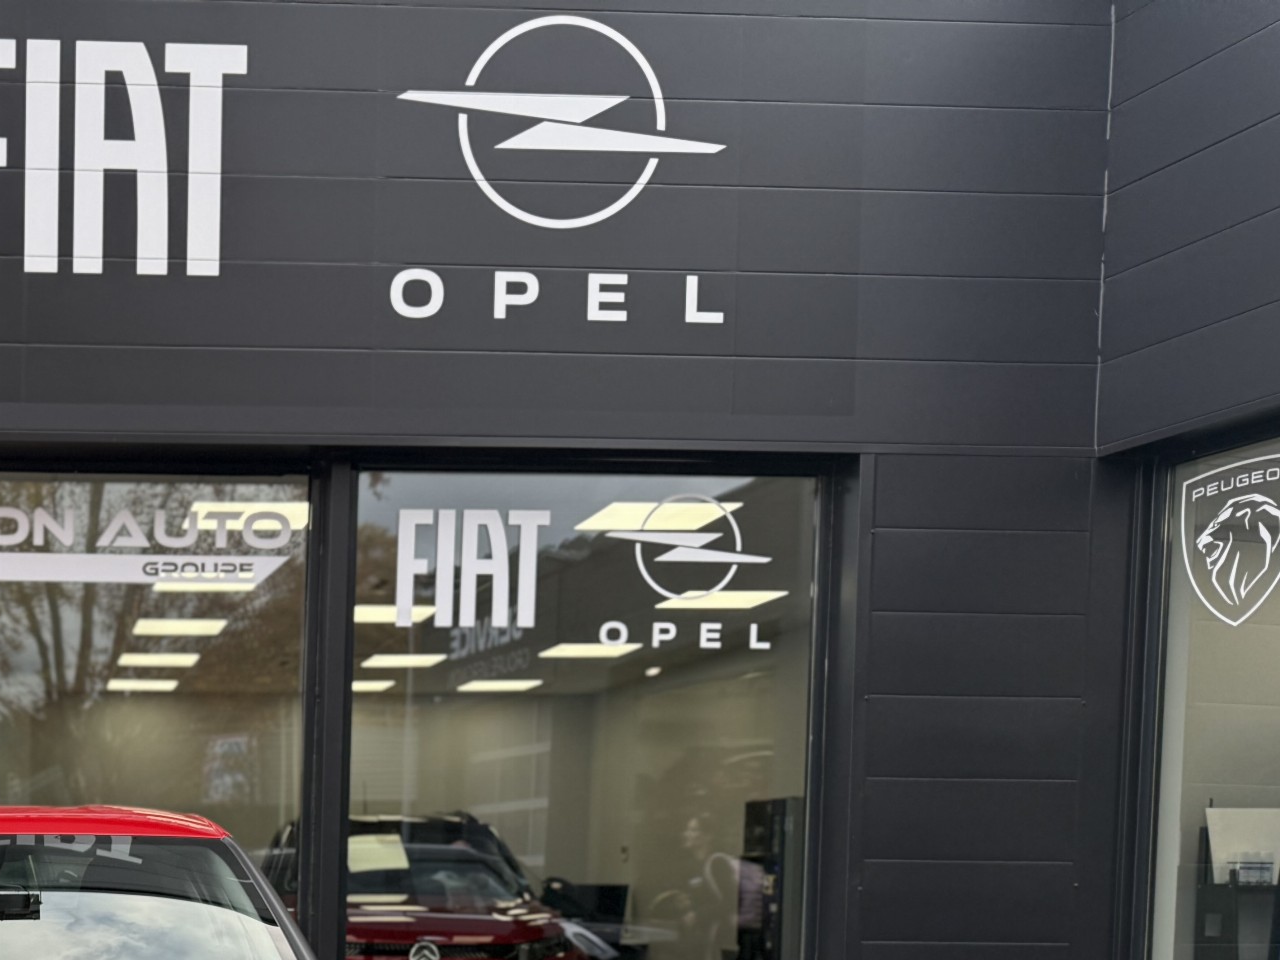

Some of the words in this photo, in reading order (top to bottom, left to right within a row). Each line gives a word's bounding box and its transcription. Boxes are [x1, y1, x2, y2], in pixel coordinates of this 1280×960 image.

[389, 267, 725, 324] OPEL
[1192, 467, 1280, 502] PEUGEO
[96, 510, 291, 549] AUTO
[141, 561, 255, 578] GROUPE
[395, 509, 551, 628] FIAT
[599, 621, 771, 650] OPEL
